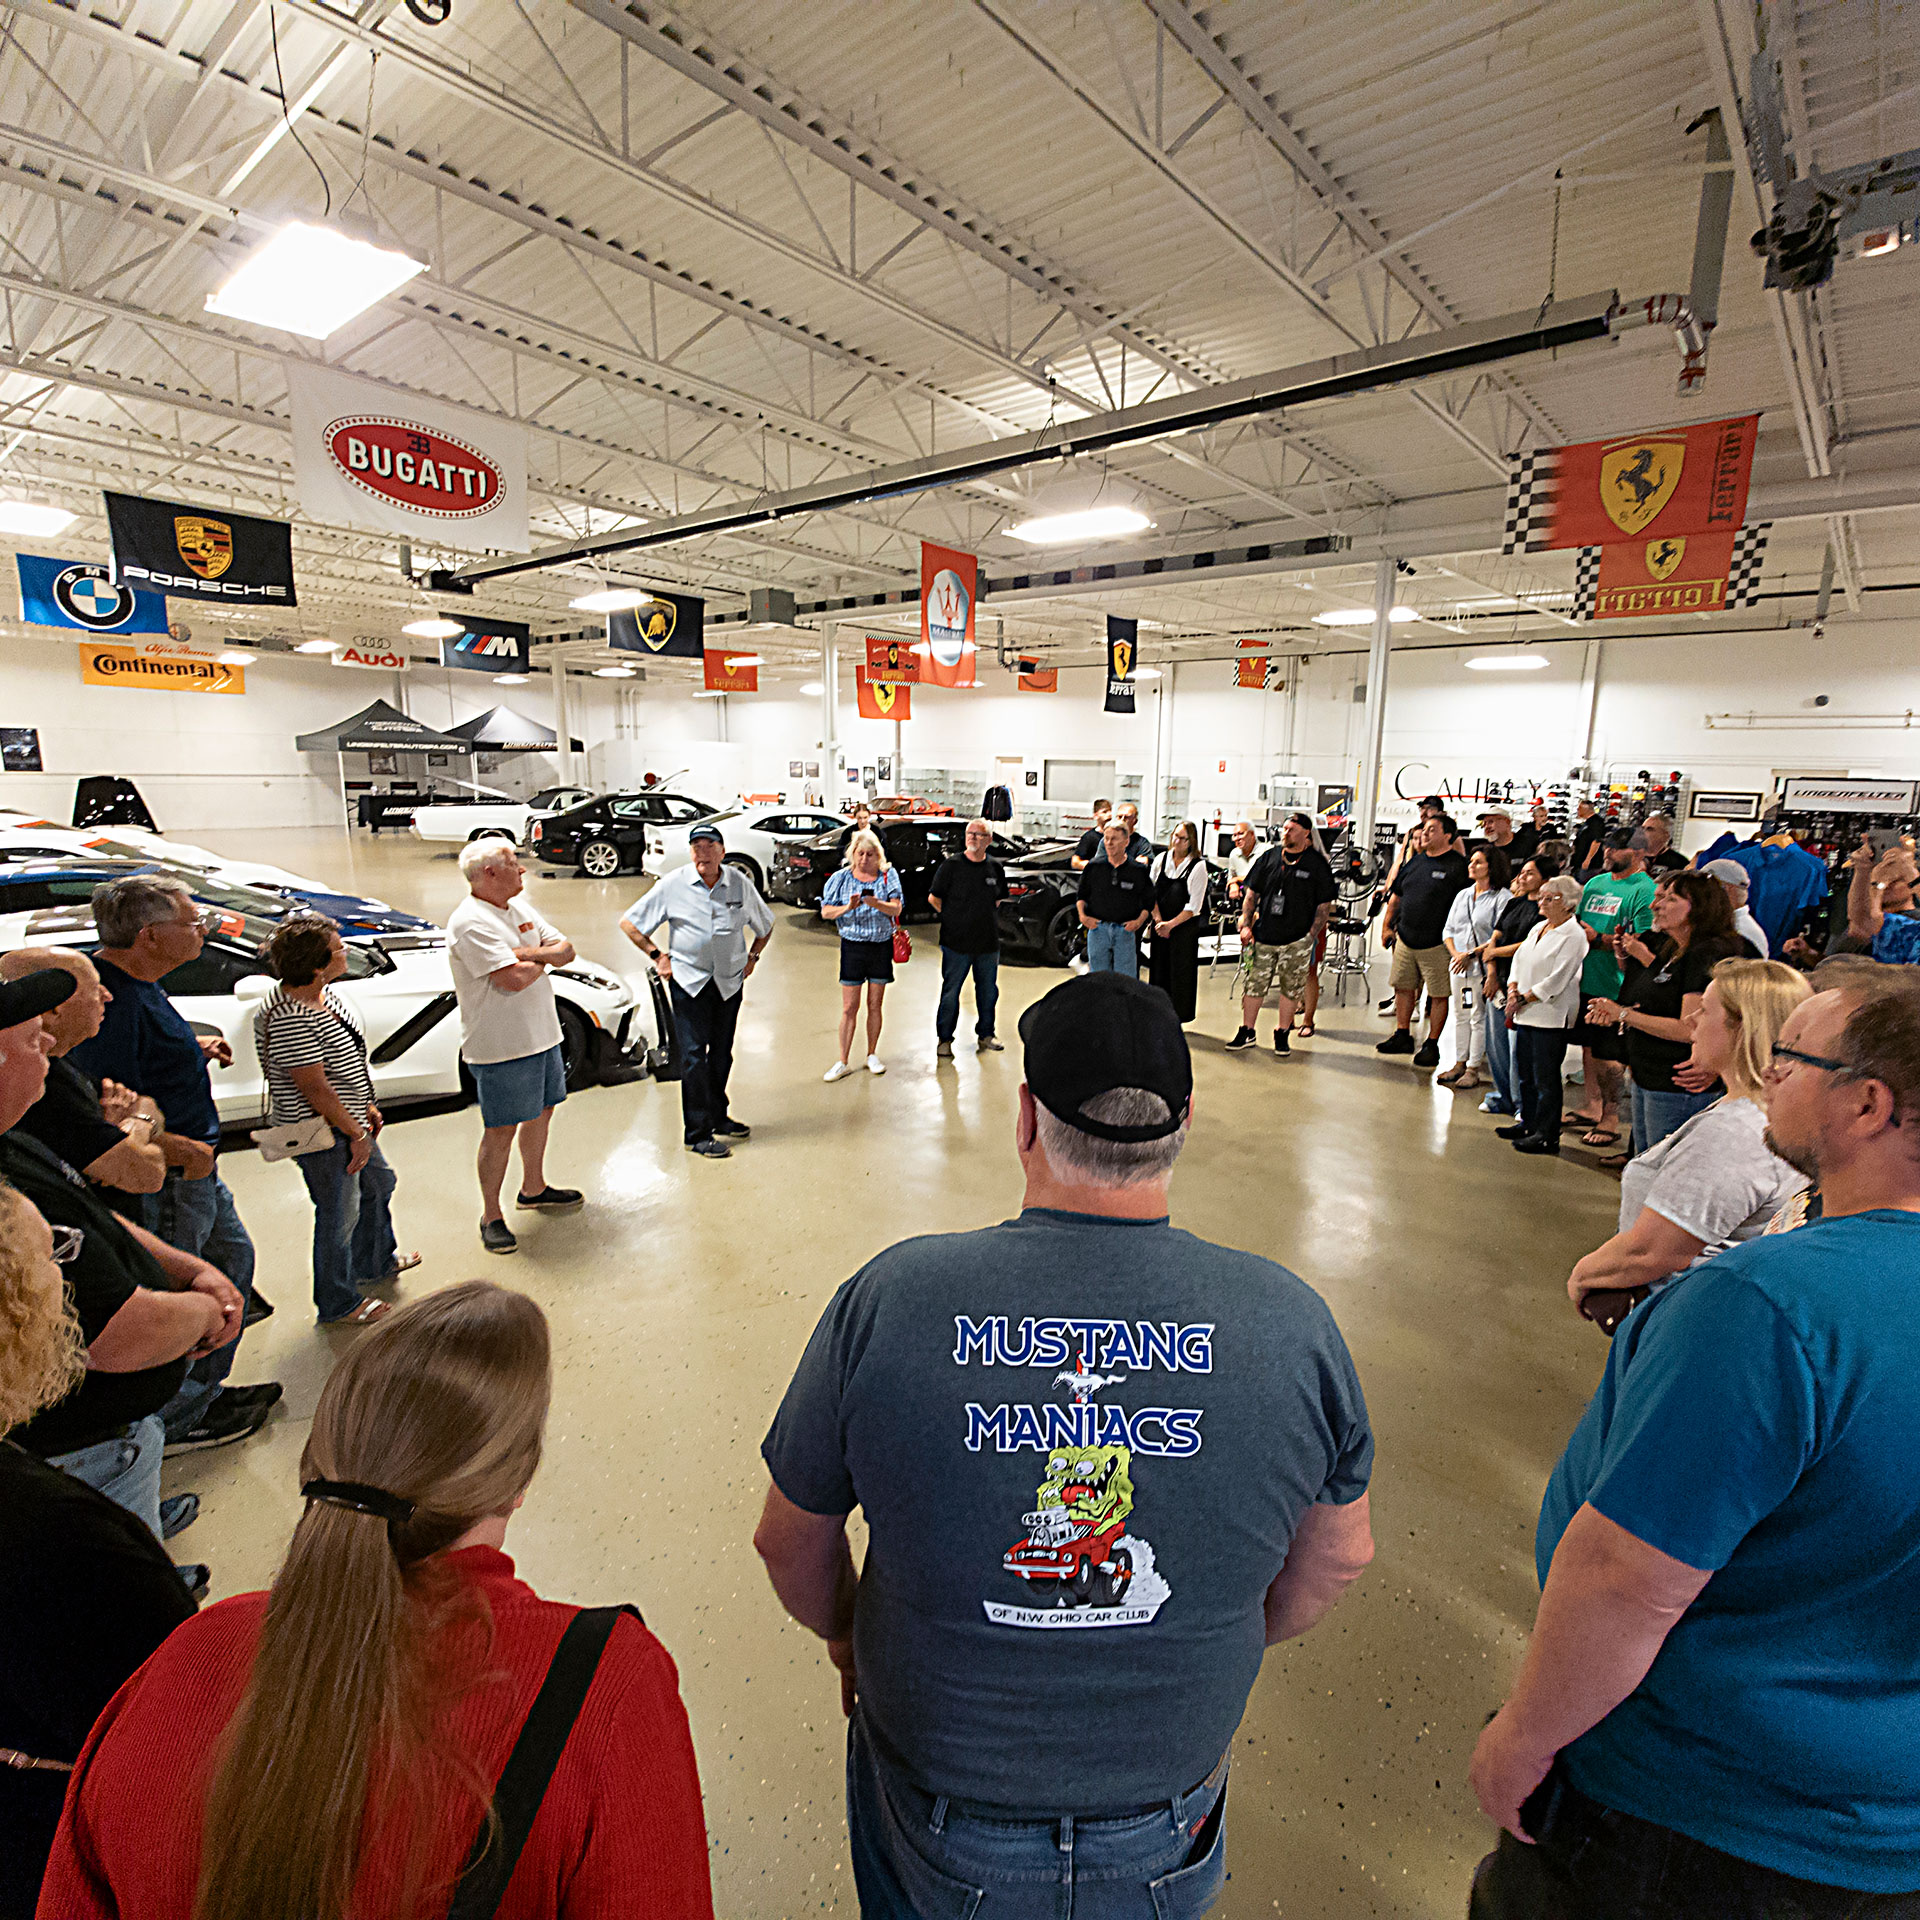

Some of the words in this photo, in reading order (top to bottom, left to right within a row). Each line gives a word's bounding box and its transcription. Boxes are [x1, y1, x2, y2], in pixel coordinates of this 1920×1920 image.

[348, 437, 487, 499] BUGATTI
[1707, 420, 1747, 524] Ferrari
[123, 565, 287, 597] PORSCHE
[93, 653, 215, 678] Continental
[1395, 762, 1547, 804] CAULY
[953, 1315, 1215, 1374] MUSTANG
[964, 1403, 1204, 1458] MANIACS
[992, 1607, 1012, 1619] OF
[1016, 1611, 1044, 1624] N.W.
[1050, 1613, 1082, 1624] OHIO
[1085, 1612, 1112, 1622] CAR
[1116, 1609, 1150, 1621] CLUB
